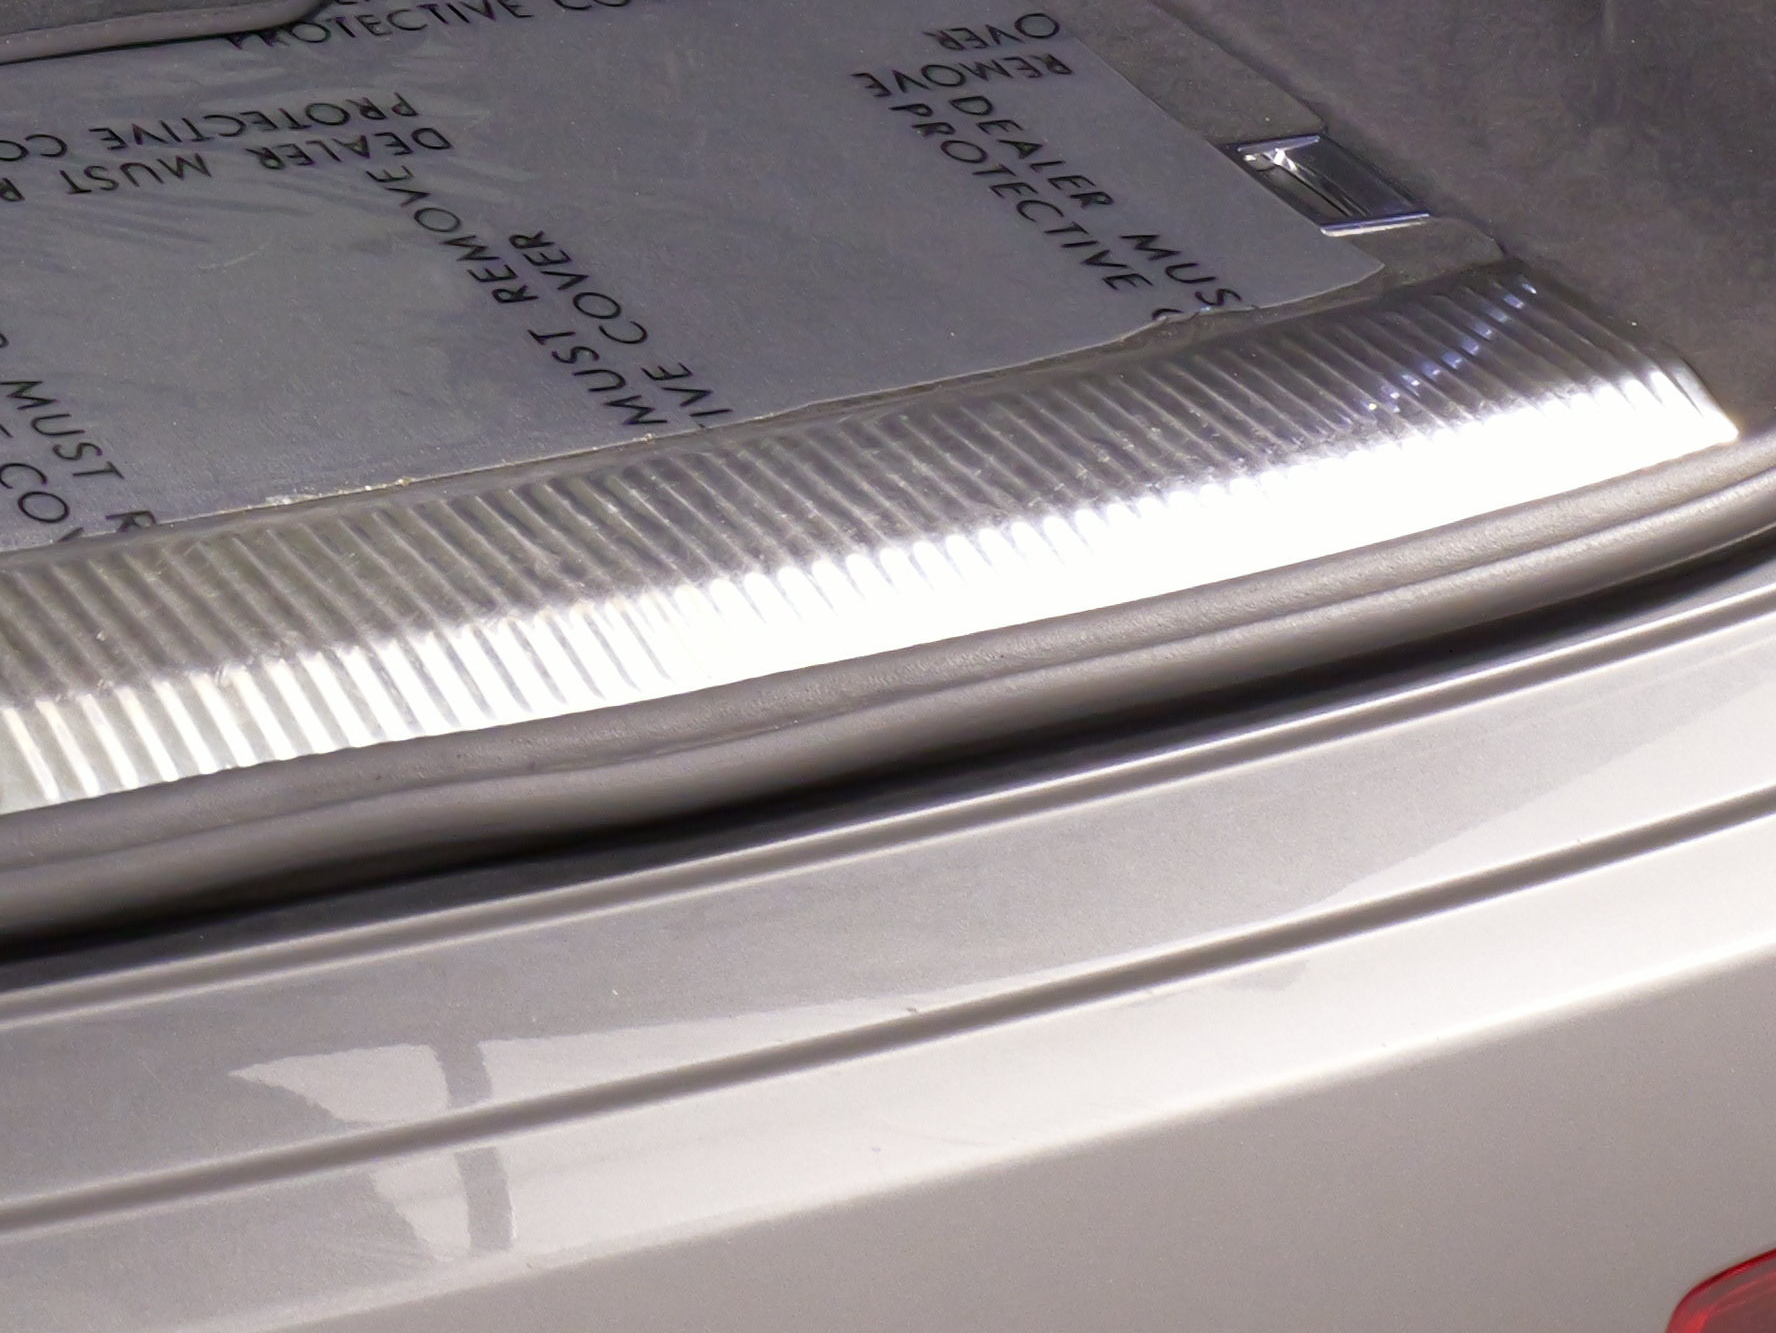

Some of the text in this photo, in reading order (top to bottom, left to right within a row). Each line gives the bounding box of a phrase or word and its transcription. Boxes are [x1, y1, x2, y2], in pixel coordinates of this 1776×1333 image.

[851, 53, 1073, 97] REMOVE
[90, 92, 418, 152] PROTECTIVE
[247, 127, 453, 172] DEALER
[948, 95, 1114, 211] DEALER
[60, 153, 212, 197] MUST
[888, 101, 1153, 293] PROTECTIVE
[367, 164, 667, 427] MUST REMOVE
[507, 230, 648, 346] COVER
